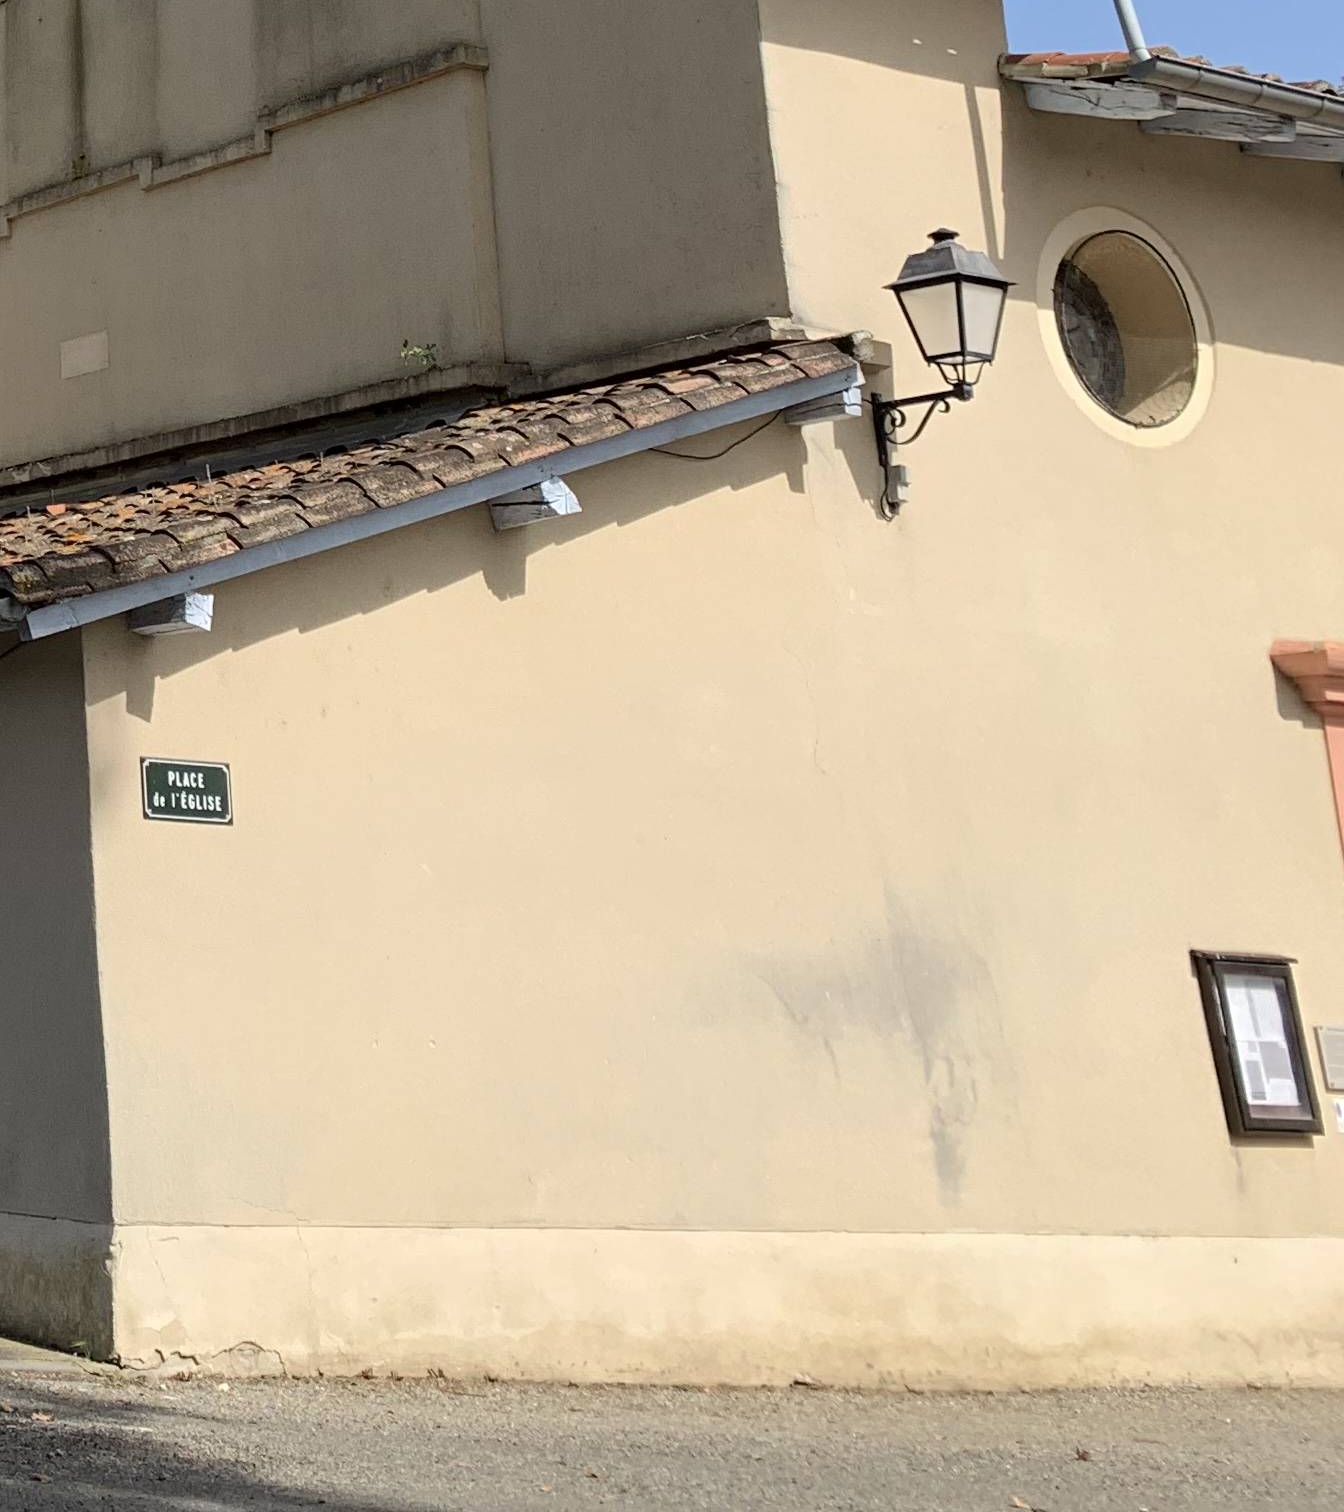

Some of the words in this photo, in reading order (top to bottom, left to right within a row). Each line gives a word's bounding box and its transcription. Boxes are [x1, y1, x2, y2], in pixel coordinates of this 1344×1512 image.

[167, 770, 205, 789] PLACE
[153, 792, 166, 808] de
[171, 791, 223, 812] l'ÉGLISE
